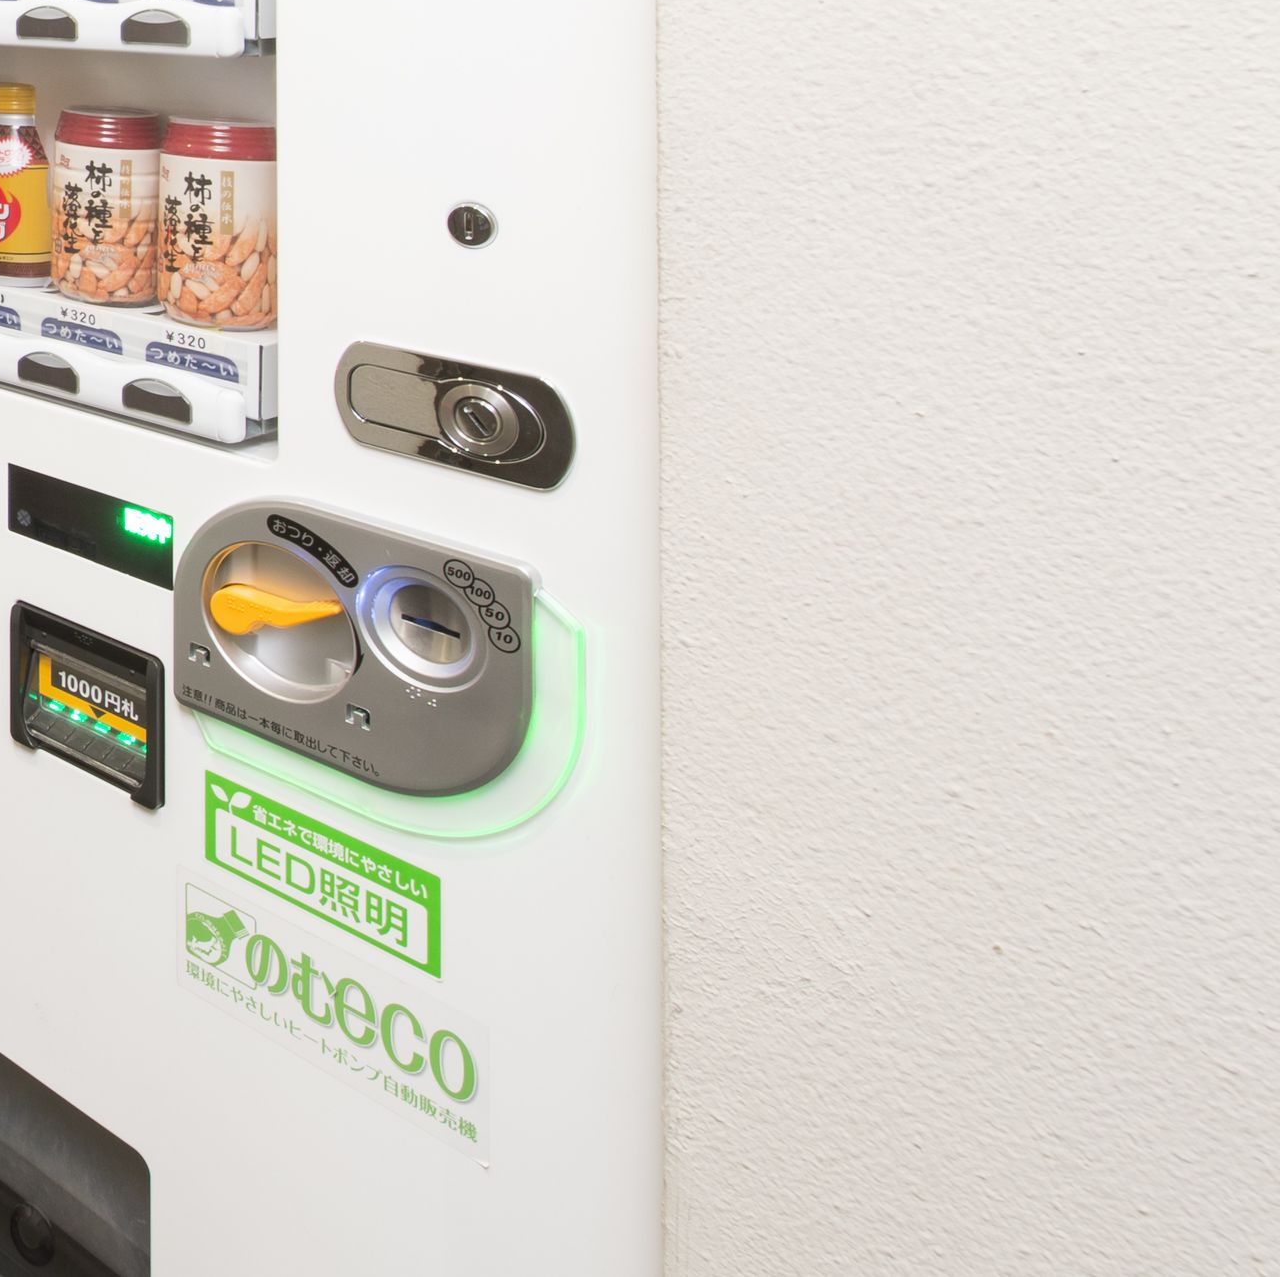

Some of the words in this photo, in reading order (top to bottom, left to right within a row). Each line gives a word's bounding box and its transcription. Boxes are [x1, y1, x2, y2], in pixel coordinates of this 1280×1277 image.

[60, 306, 96, 326] ¥320
[166, 330, 206, 350] ¥320
[447, 565, 471, 582] 500
[468, 585, 492, 601] 100
[484, 606, 506, 621] 50
[494, 630, 513, 644] 10
[57, 670, 139, 722] 1000円札
[252, 804, 428, 900] 省エネで環境にやさしい
[230, 825, 409, 948] LED照明
[244, 932, 478, 1104] のむeco
[186, 959, 479, 1144] 環境にやさしいヒートポンプ自動販売機
